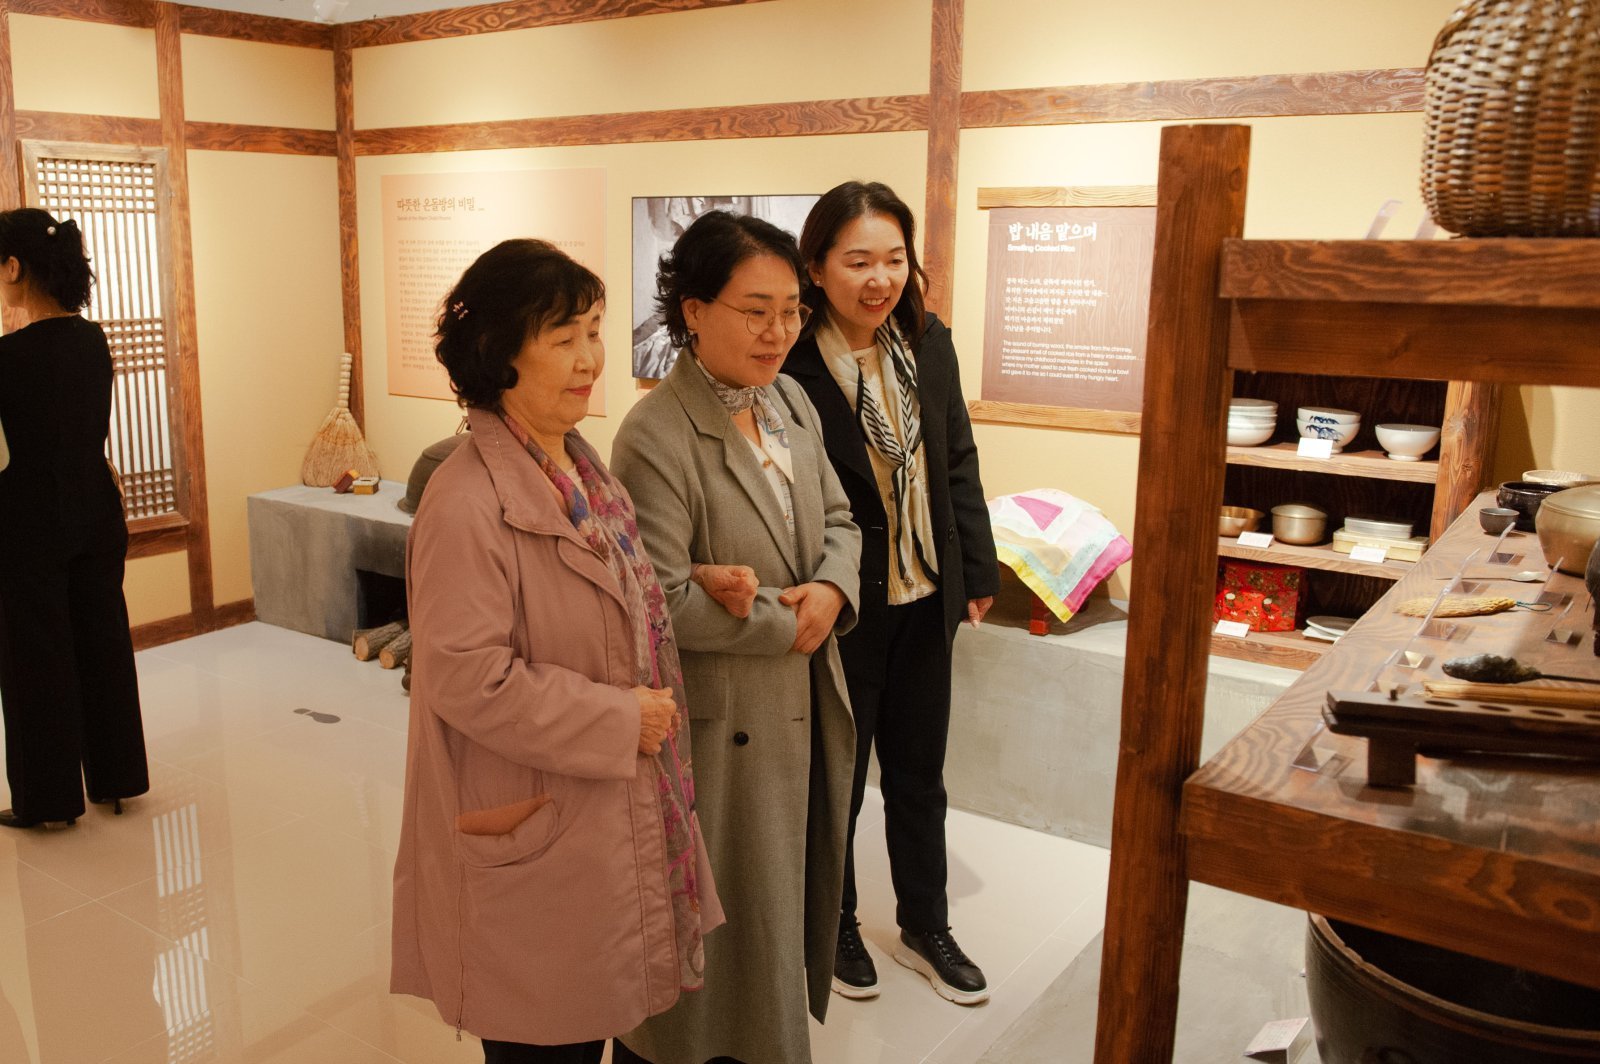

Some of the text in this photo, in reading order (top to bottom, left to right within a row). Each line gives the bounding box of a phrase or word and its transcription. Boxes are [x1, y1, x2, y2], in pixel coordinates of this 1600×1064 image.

[397, 196, 475, 212] 따뜻한 온돌방의 비밀
[1008, 222, 1097, 241] 밥 내음 맡으며
[1008, 244, 1034, 253] Smelling
